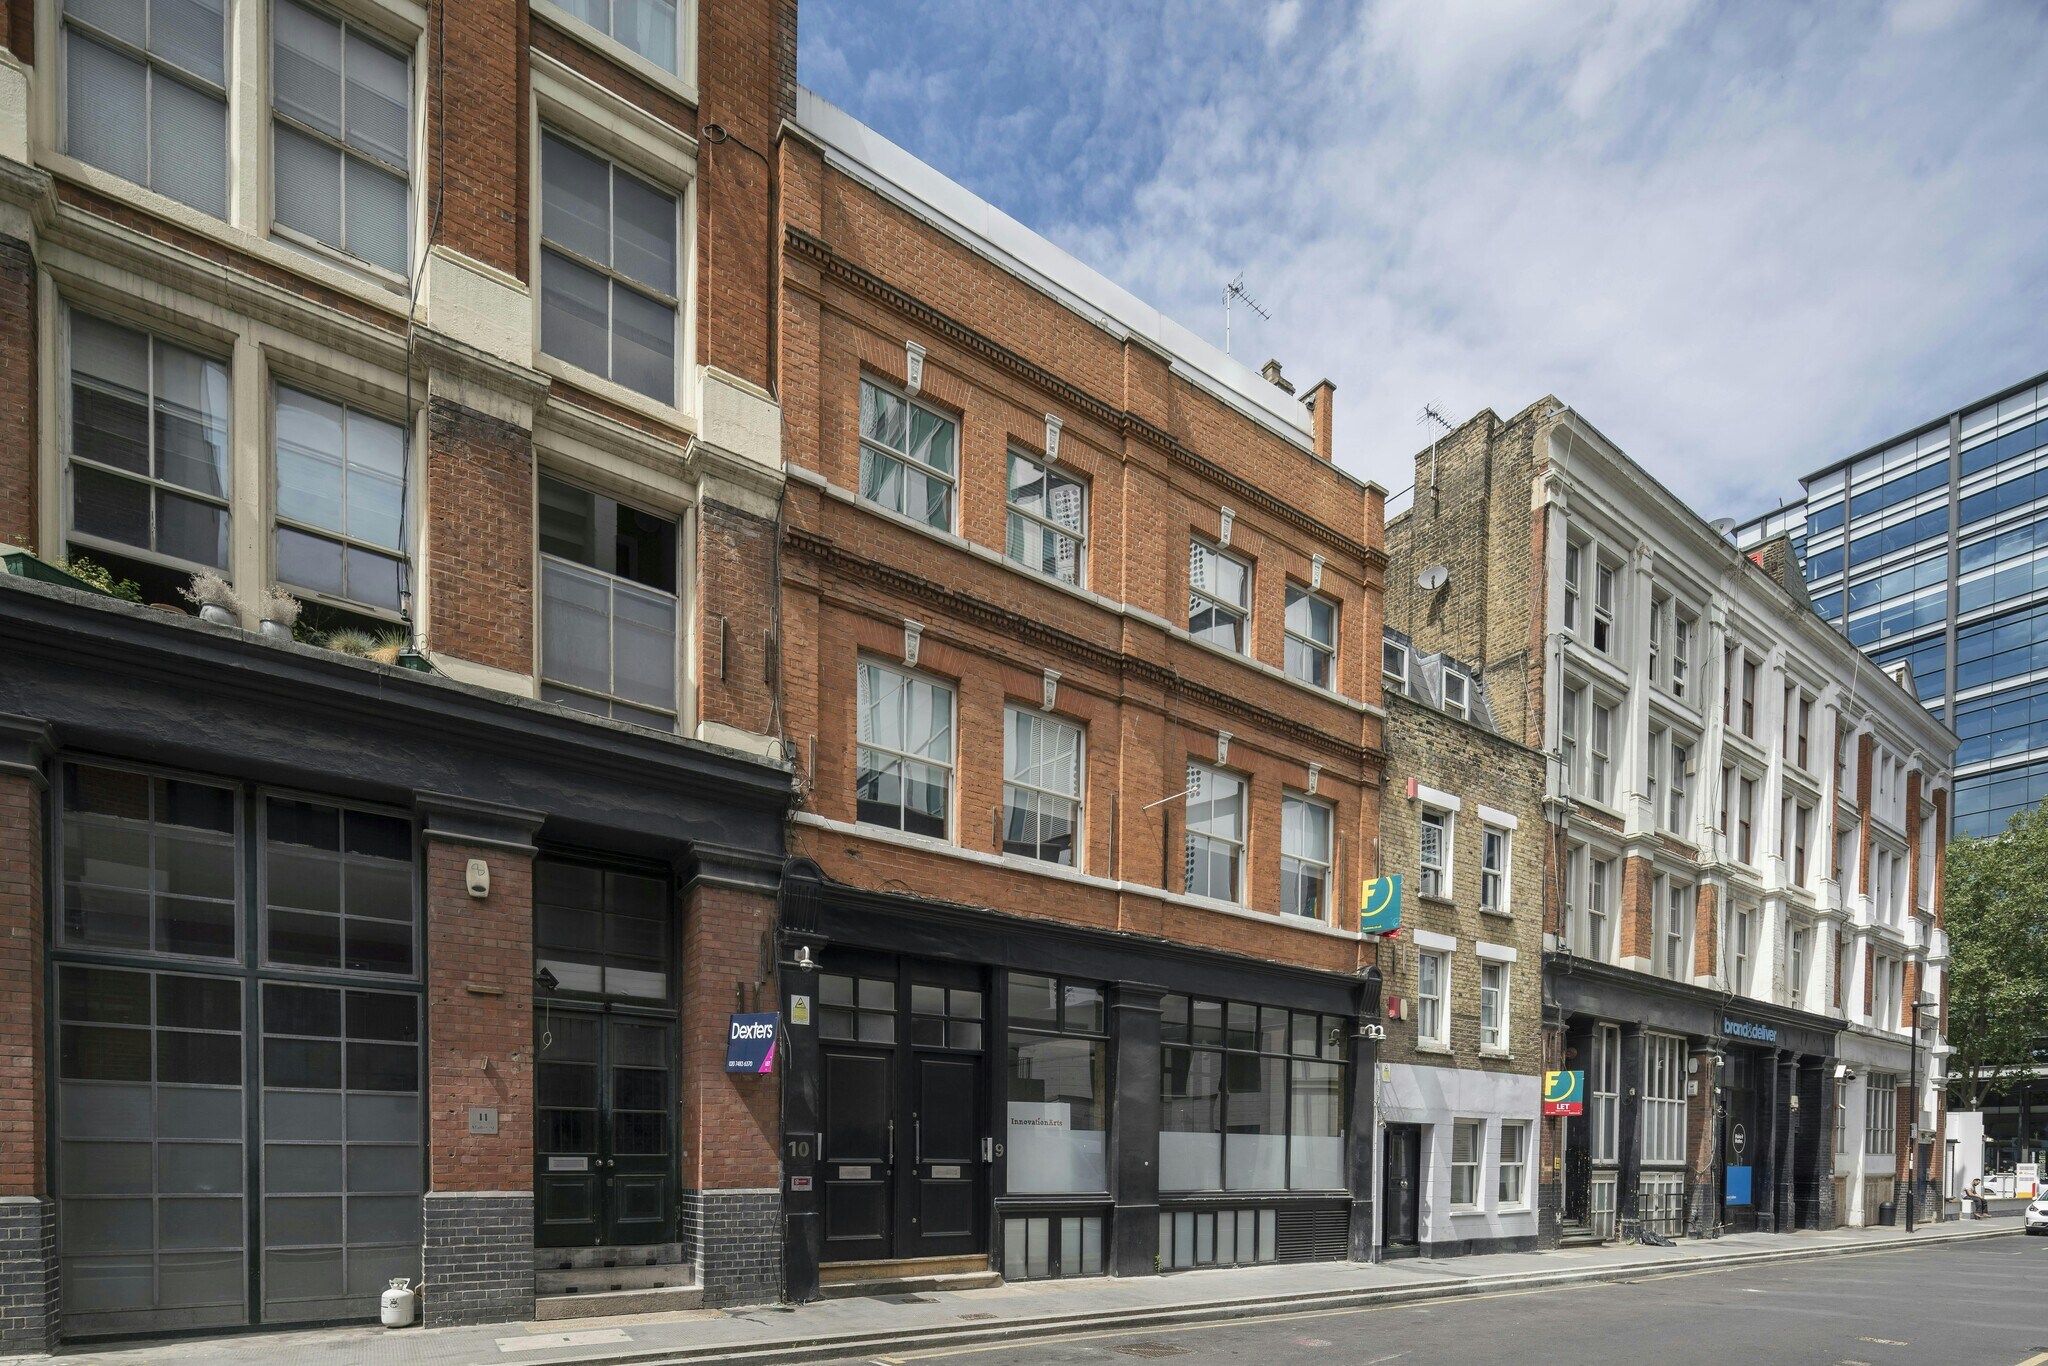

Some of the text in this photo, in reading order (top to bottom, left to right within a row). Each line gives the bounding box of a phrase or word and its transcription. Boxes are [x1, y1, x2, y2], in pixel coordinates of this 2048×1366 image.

[1361, 878, 1379, 910] F
[732, 1021, 773, 1040] Dexters
[1725, 1016, 1776, 1042] brand&deliver
[1545, 1071, 1562, 1096] F
[479, 1113, 488, 1121] 11
[1011, 1117, 1063, 1127] InnovationArts
[788, 1141, 810, 1158] 10
[995, 1143, 1004, 1157] 9
